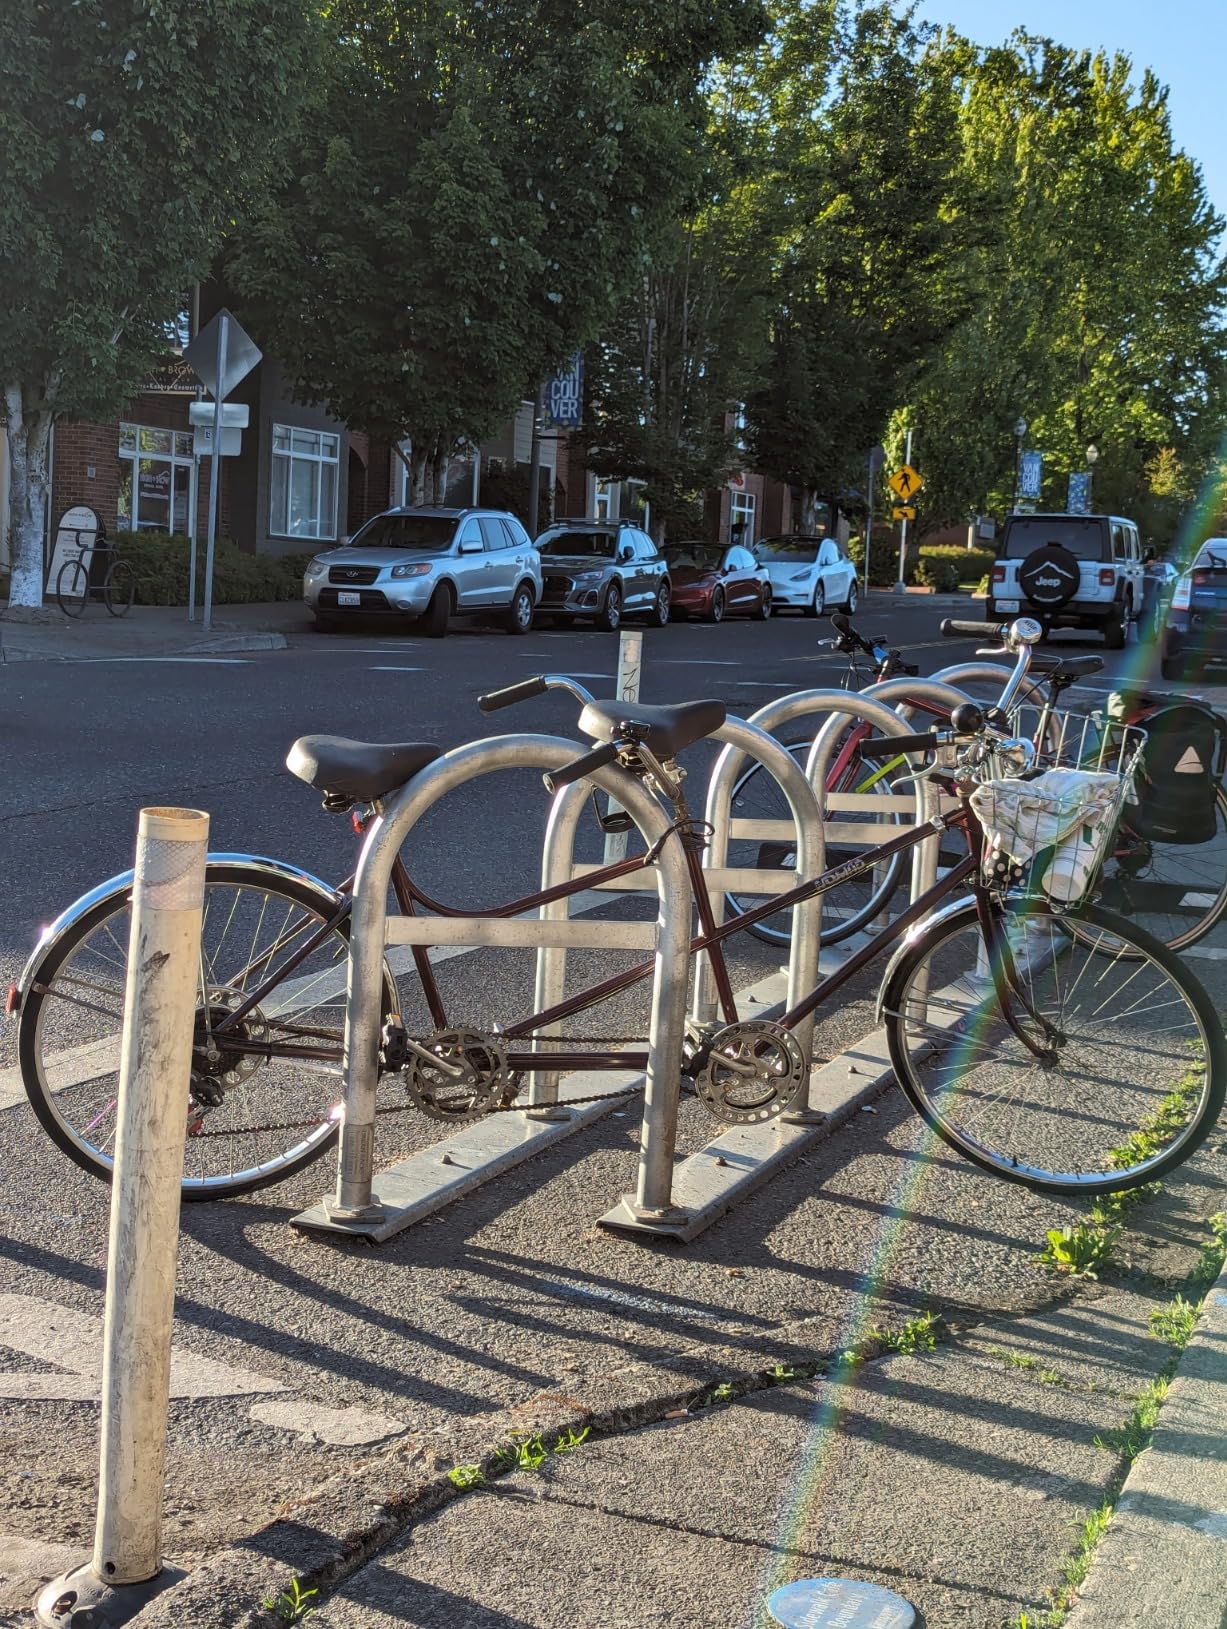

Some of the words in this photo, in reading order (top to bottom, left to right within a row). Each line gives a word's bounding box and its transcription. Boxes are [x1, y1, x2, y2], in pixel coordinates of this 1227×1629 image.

[551, 380, 579, 400] COU
[551, 400, 578, 418] VER
[1023, 463, 1040, 473] VAN
[1022, 473, 1039, 482] COU
[1022, 483, 1038, 493] VER
[1035, 576, 1061, 587] Jeep
[826, 1593, 870, 1628] Boundary
